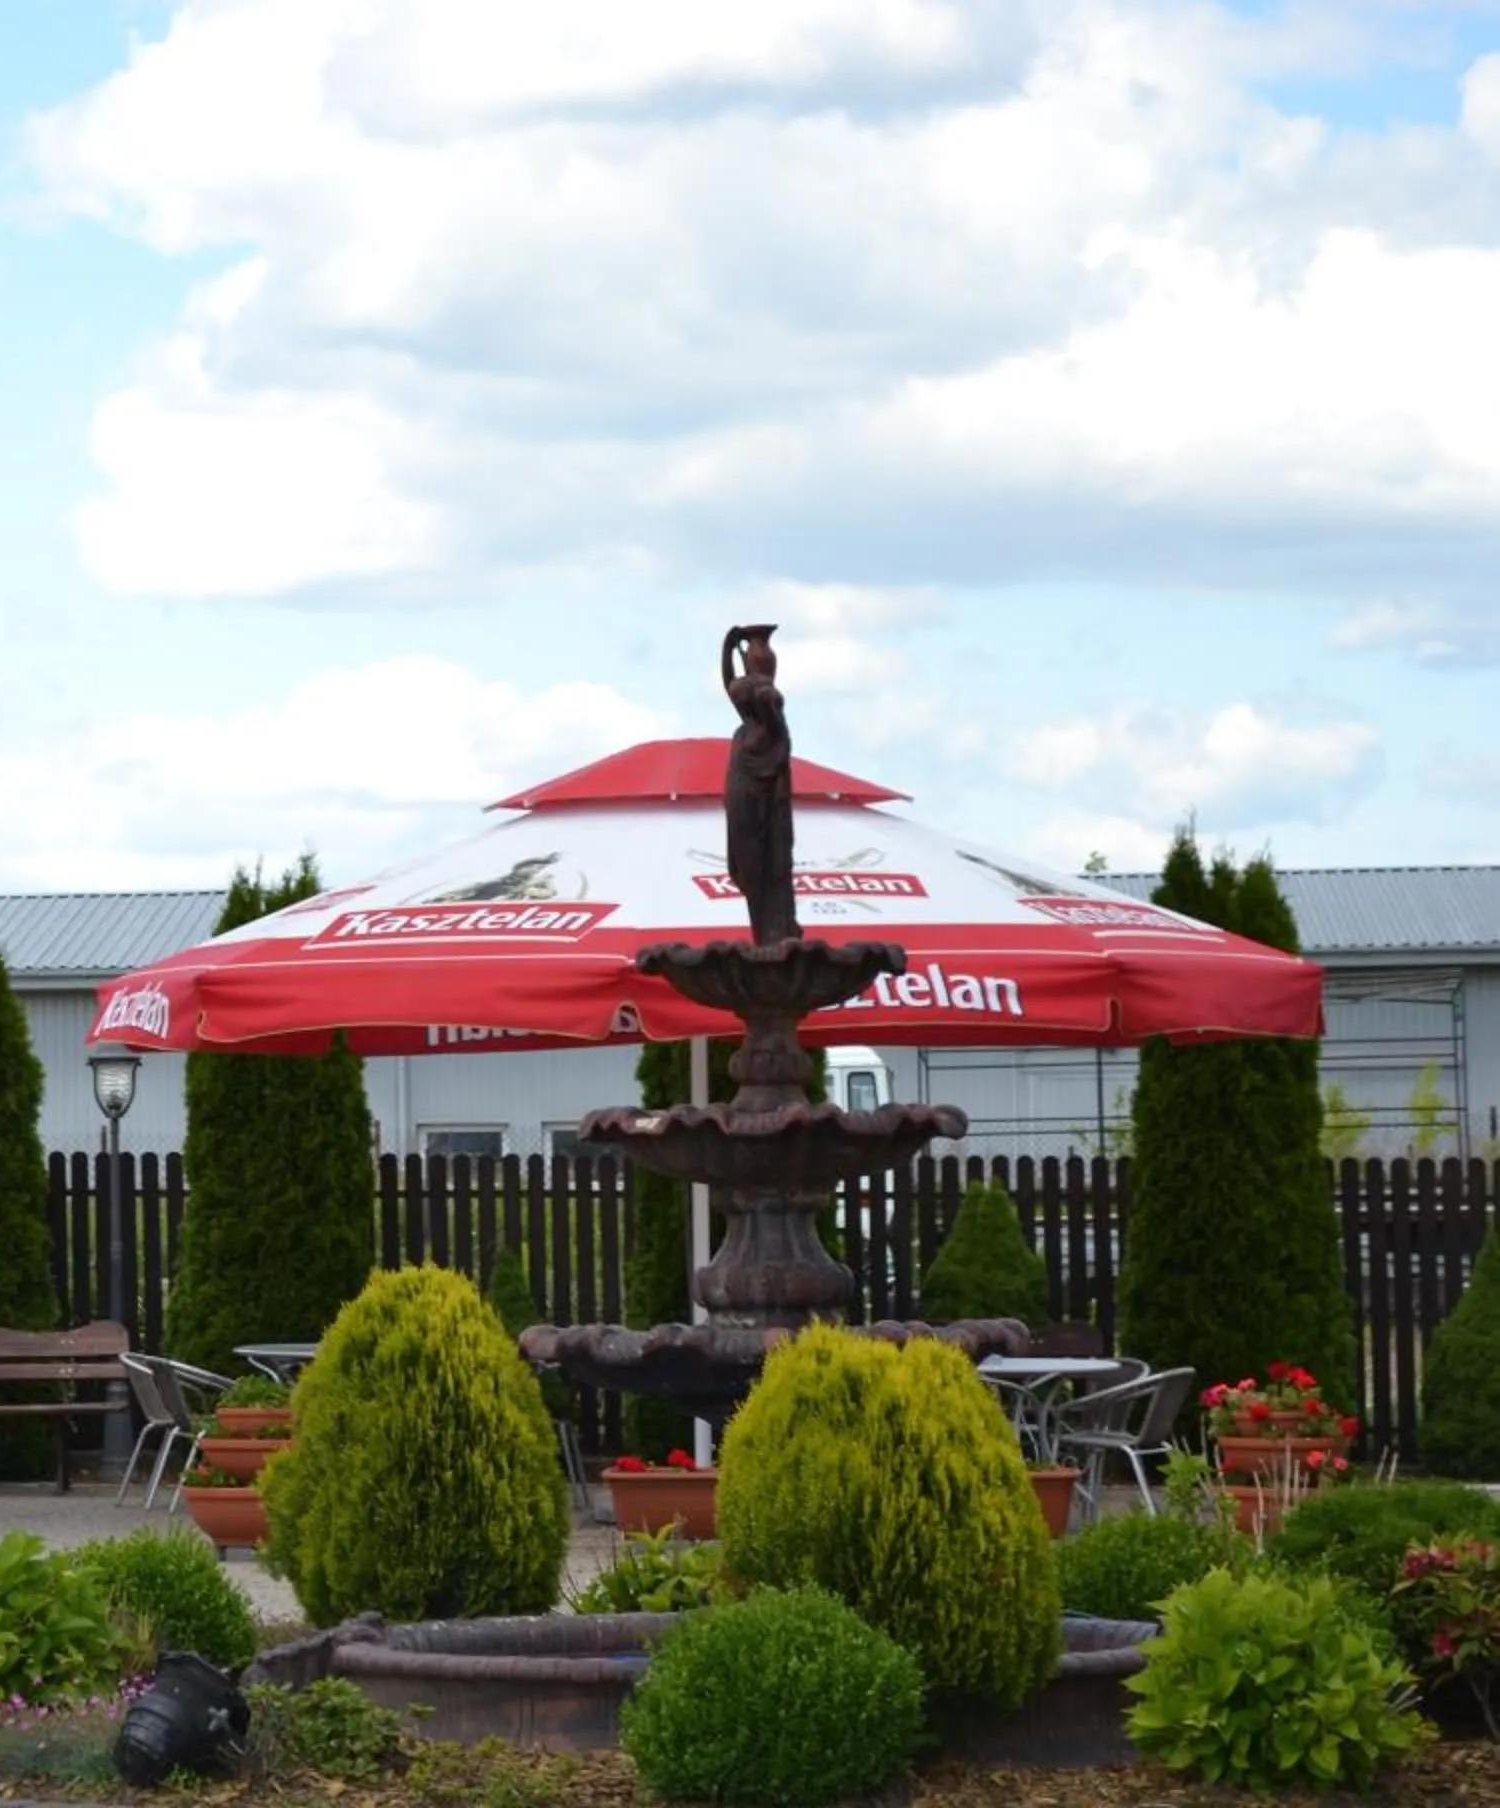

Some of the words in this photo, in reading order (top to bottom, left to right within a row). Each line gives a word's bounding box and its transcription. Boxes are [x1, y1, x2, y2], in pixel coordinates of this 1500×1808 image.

[699, 875, 913, 894] Ktelan
[335, 905, 594, 938] Kasztelan
[816, 963, 1023, 1016] telan
